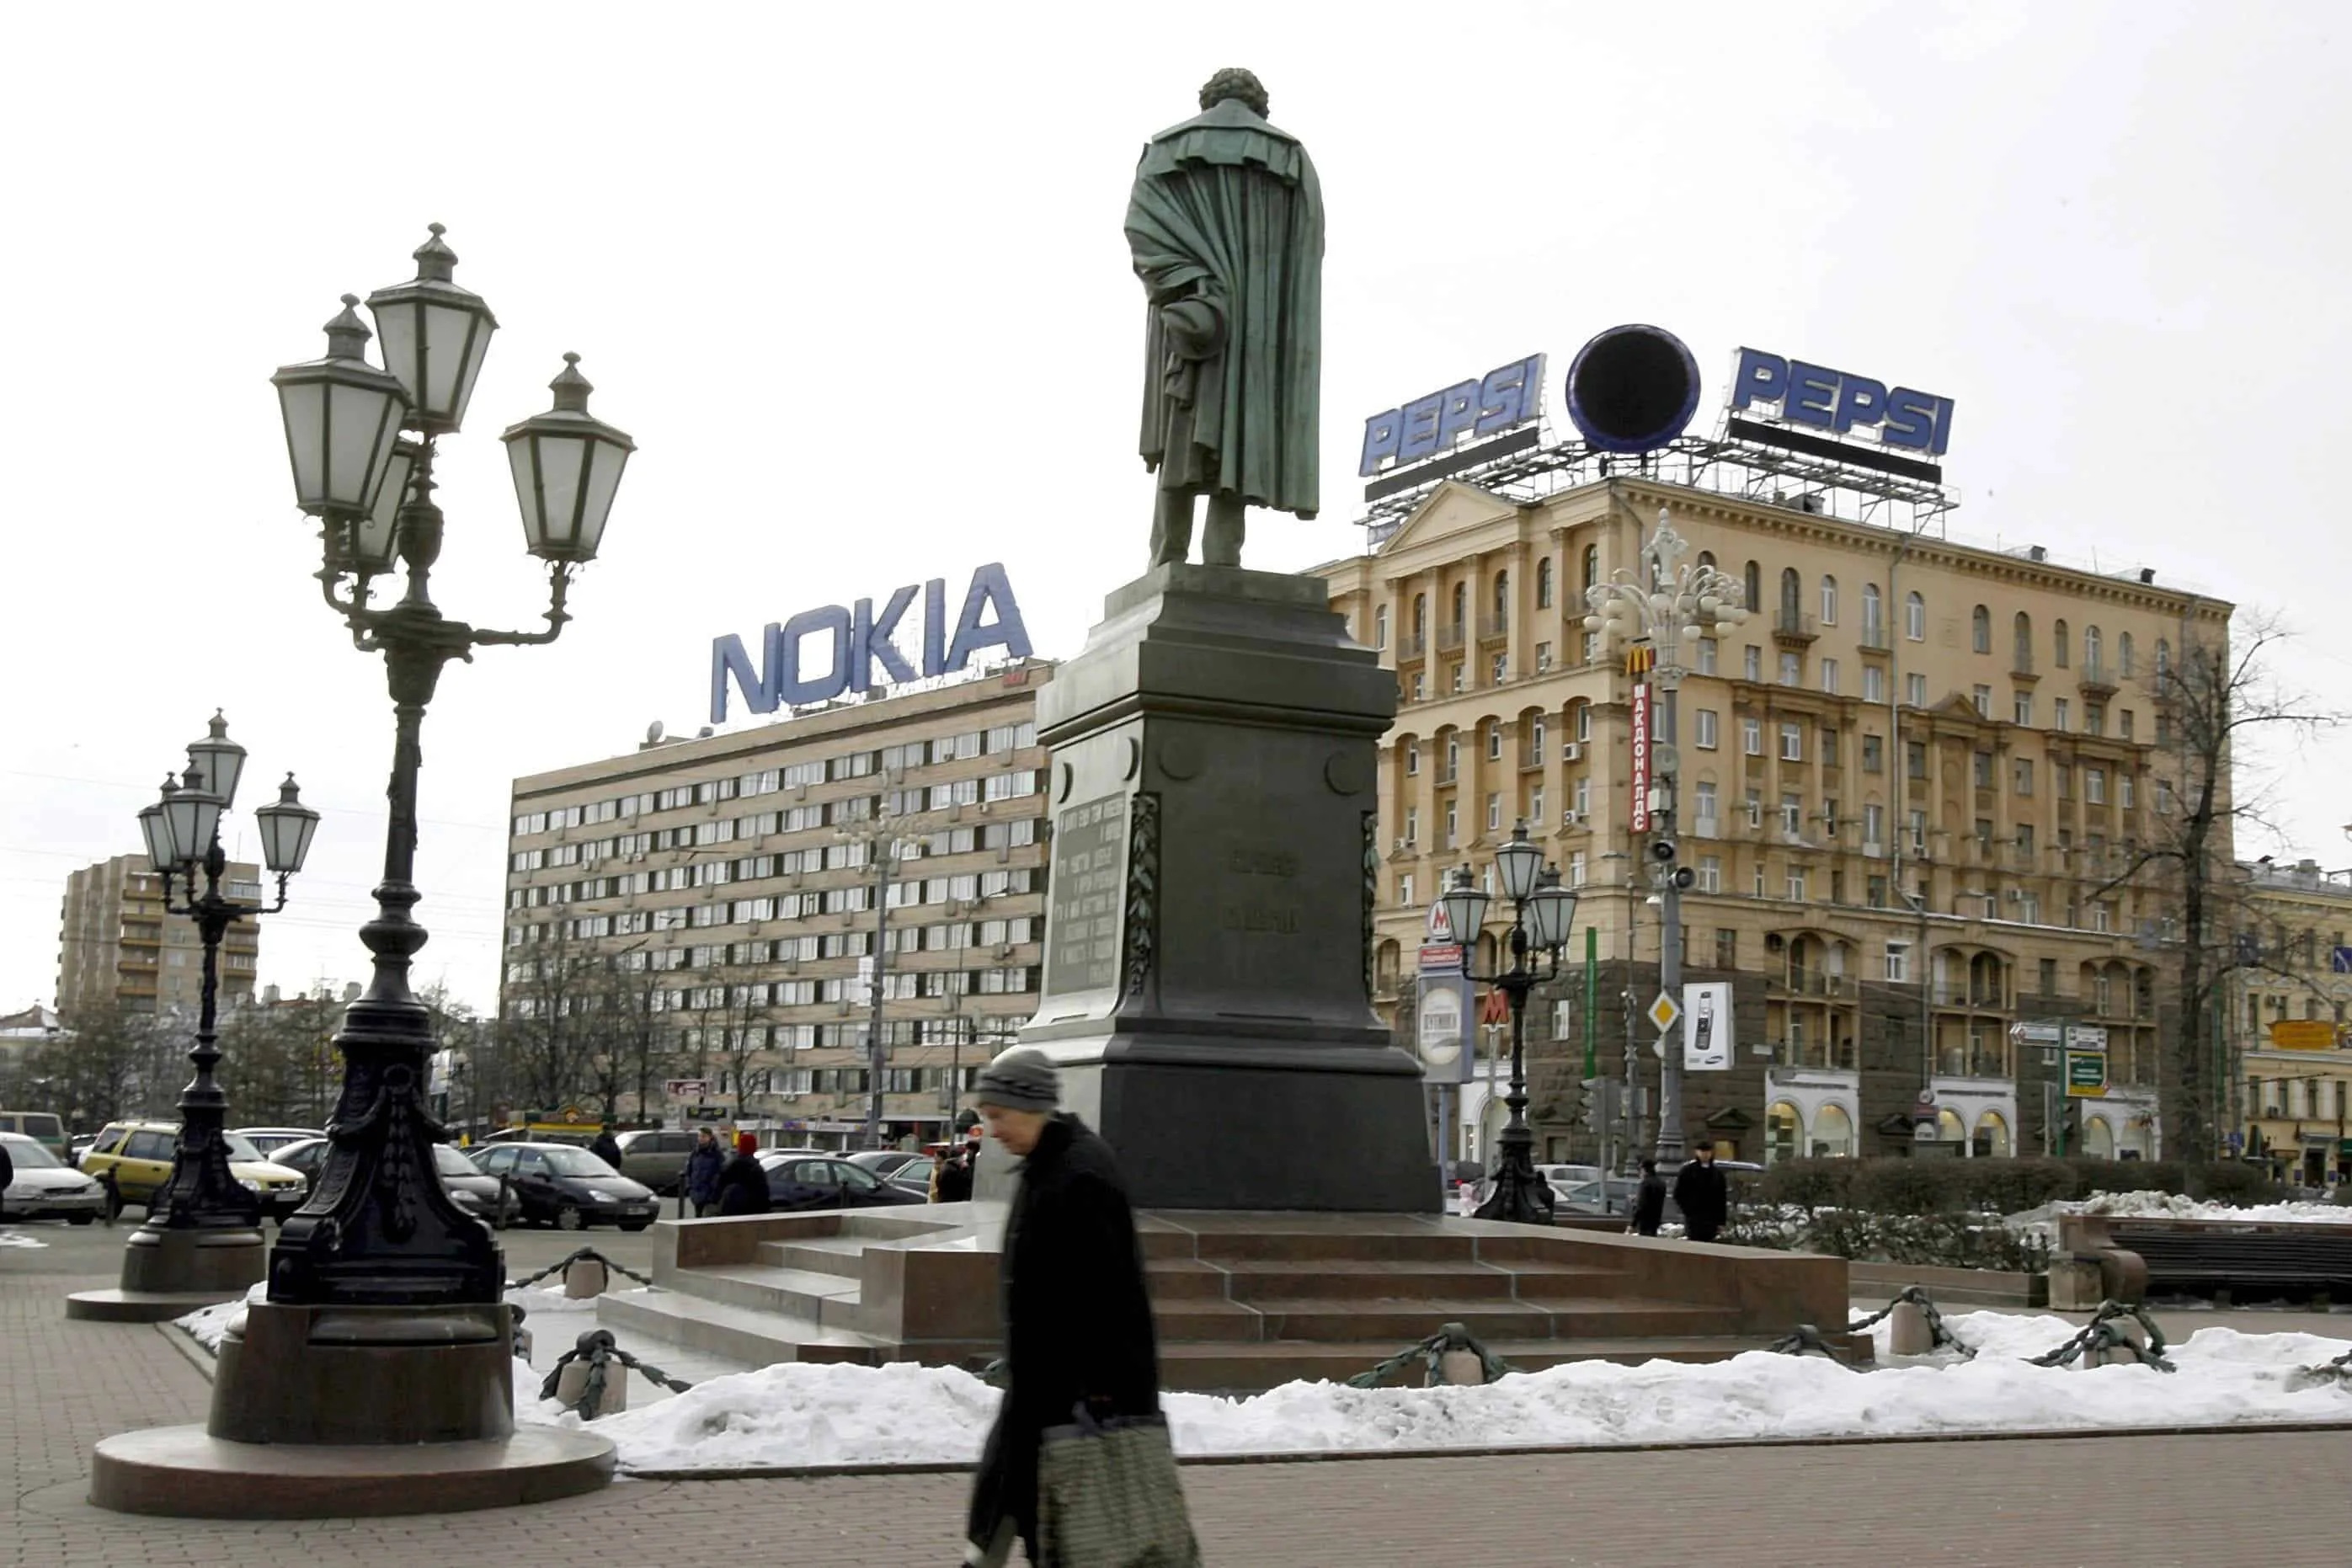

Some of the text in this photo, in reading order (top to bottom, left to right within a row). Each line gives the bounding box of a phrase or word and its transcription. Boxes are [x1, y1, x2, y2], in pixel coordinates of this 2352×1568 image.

[1358, 353, 1546, 477] PEPSI
[1735, 347, 1955, 455] PEPSI
[711, 562, 1034, 723] NOKIA
[1633, 684, 1645, 829] МАКДОНАЛДС
